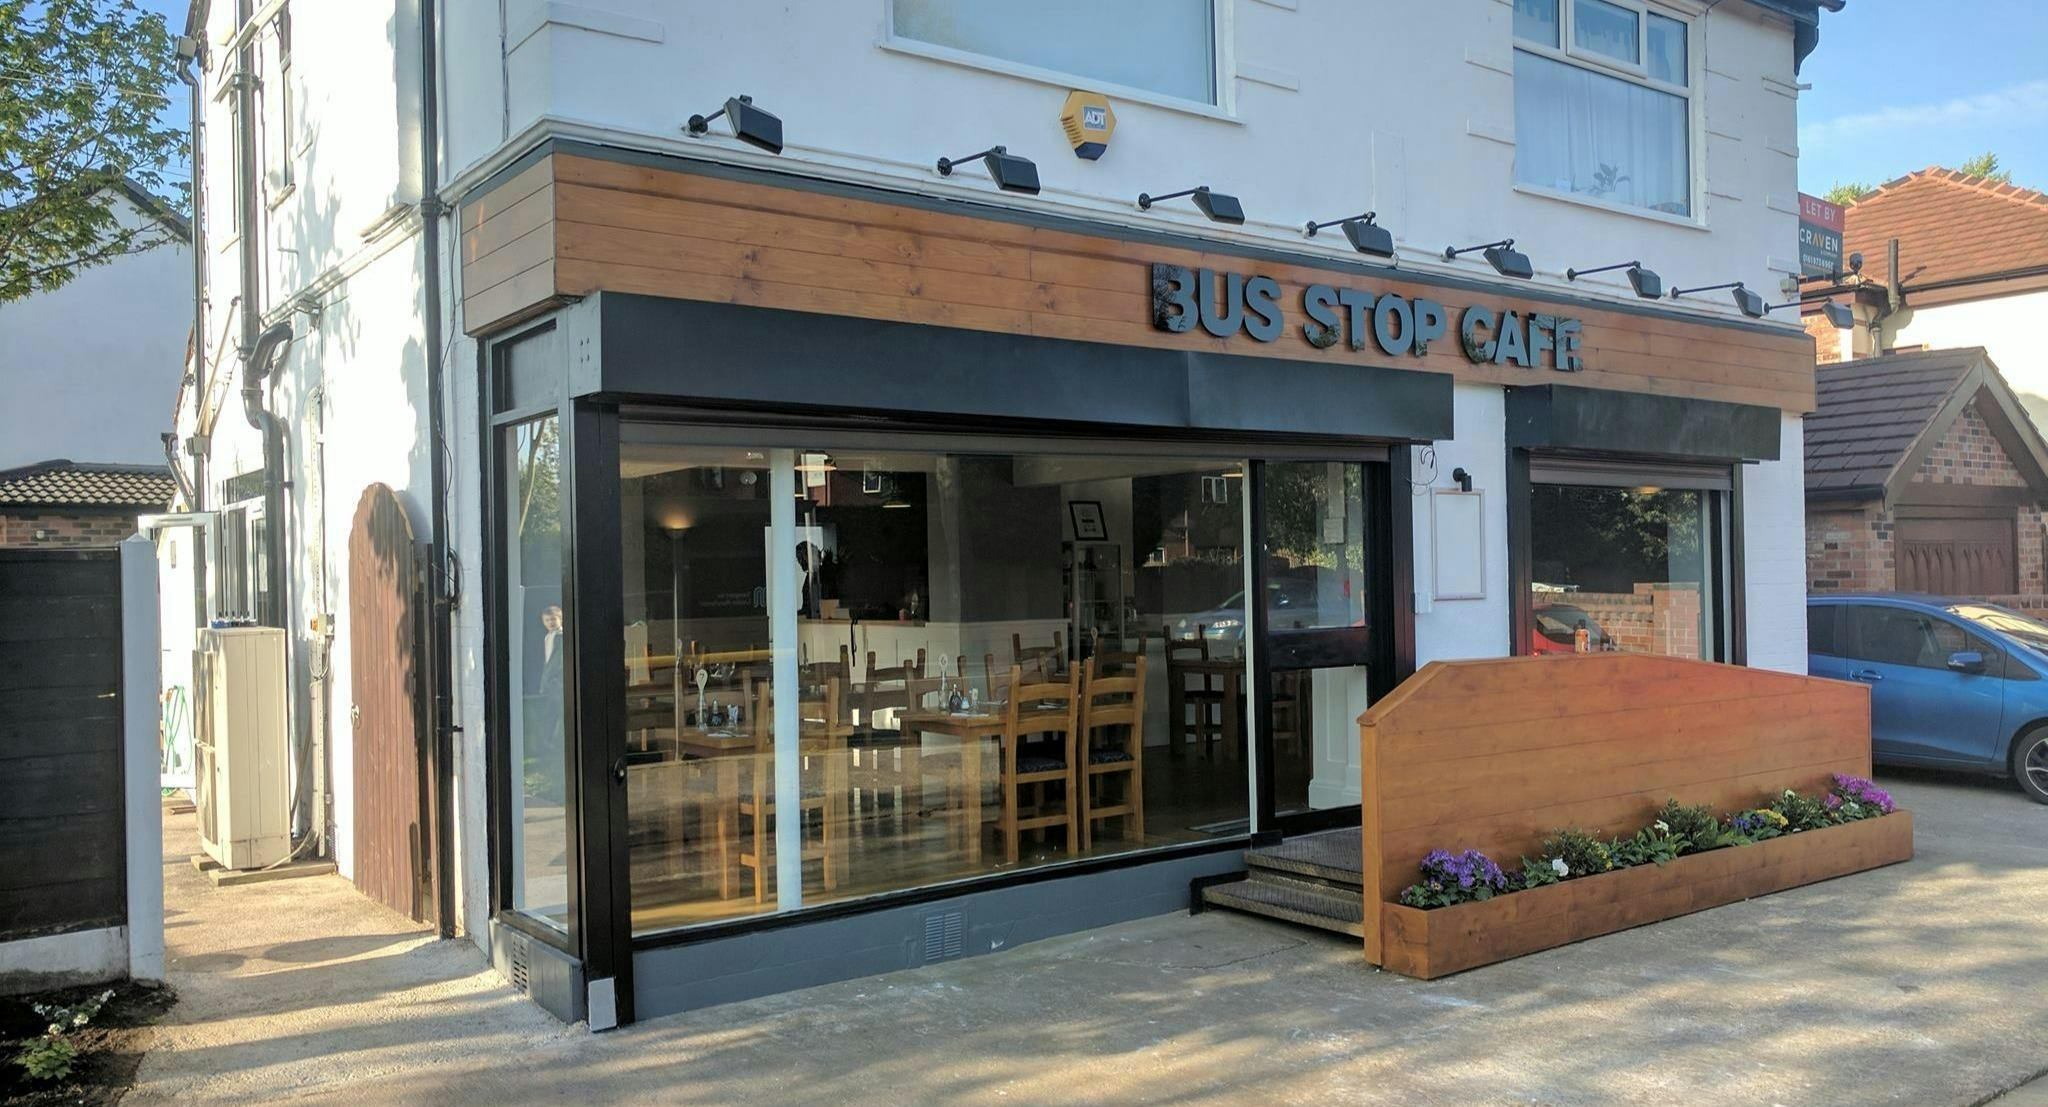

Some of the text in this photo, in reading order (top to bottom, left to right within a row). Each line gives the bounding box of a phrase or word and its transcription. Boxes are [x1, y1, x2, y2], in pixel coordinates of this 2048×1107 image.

[1085, 109, 1105, 125] ADT
[1805, 200, 1836, 221] LET BY
[1799, 228, 1838, 253] CRAVEN
[1152, 262, 1583, 372] BUS STOP CAFE
